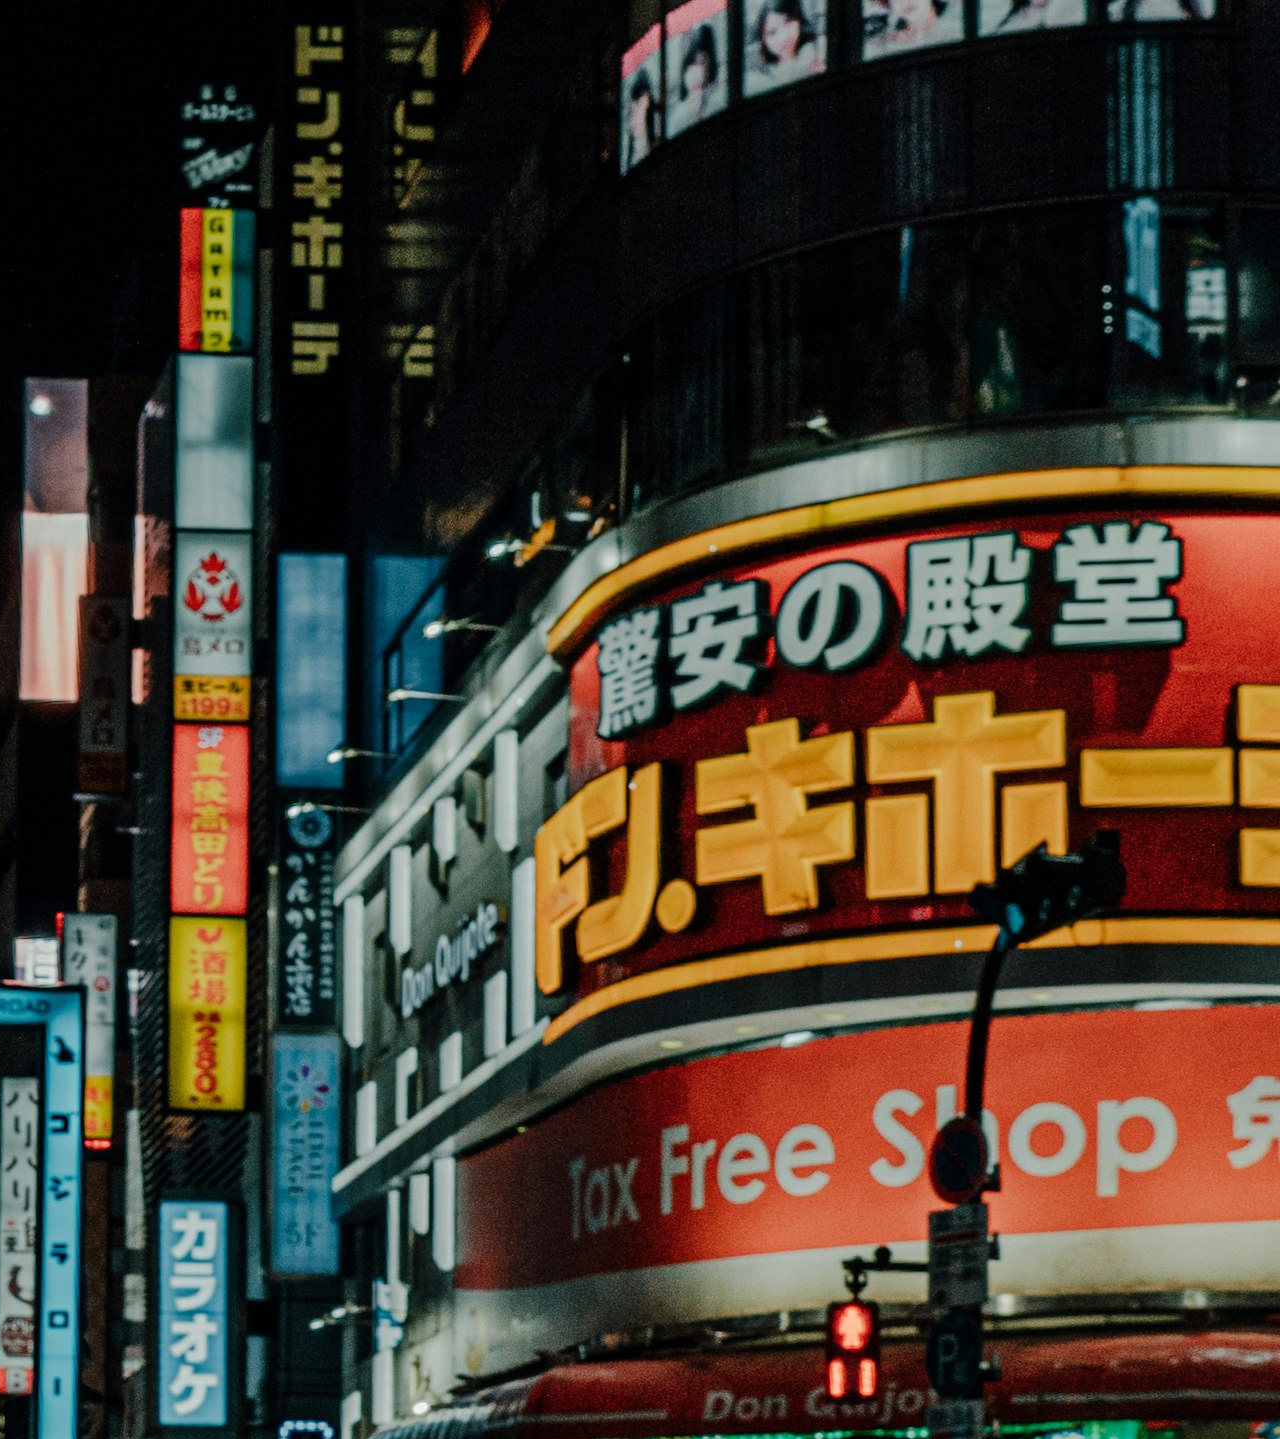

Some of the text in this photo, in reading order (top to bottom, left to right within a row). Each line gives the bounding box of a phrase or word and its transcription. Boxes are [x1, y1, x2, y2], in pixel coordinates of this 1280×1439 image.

[596, 521, 1186, 741] 驚安の殿堂
[190, 948, 226, 1006] 酒場
[400, 901, 498, 1019] Don Quijote
[567, 1151, 641, 1238] Tax
[659, 1121, 833, 1217] Free
[869, 1086, 1180, 1199] Shop
[168, 1208, 218, 1417] カラオケ
[703, 1389, 789, 1423] Don
